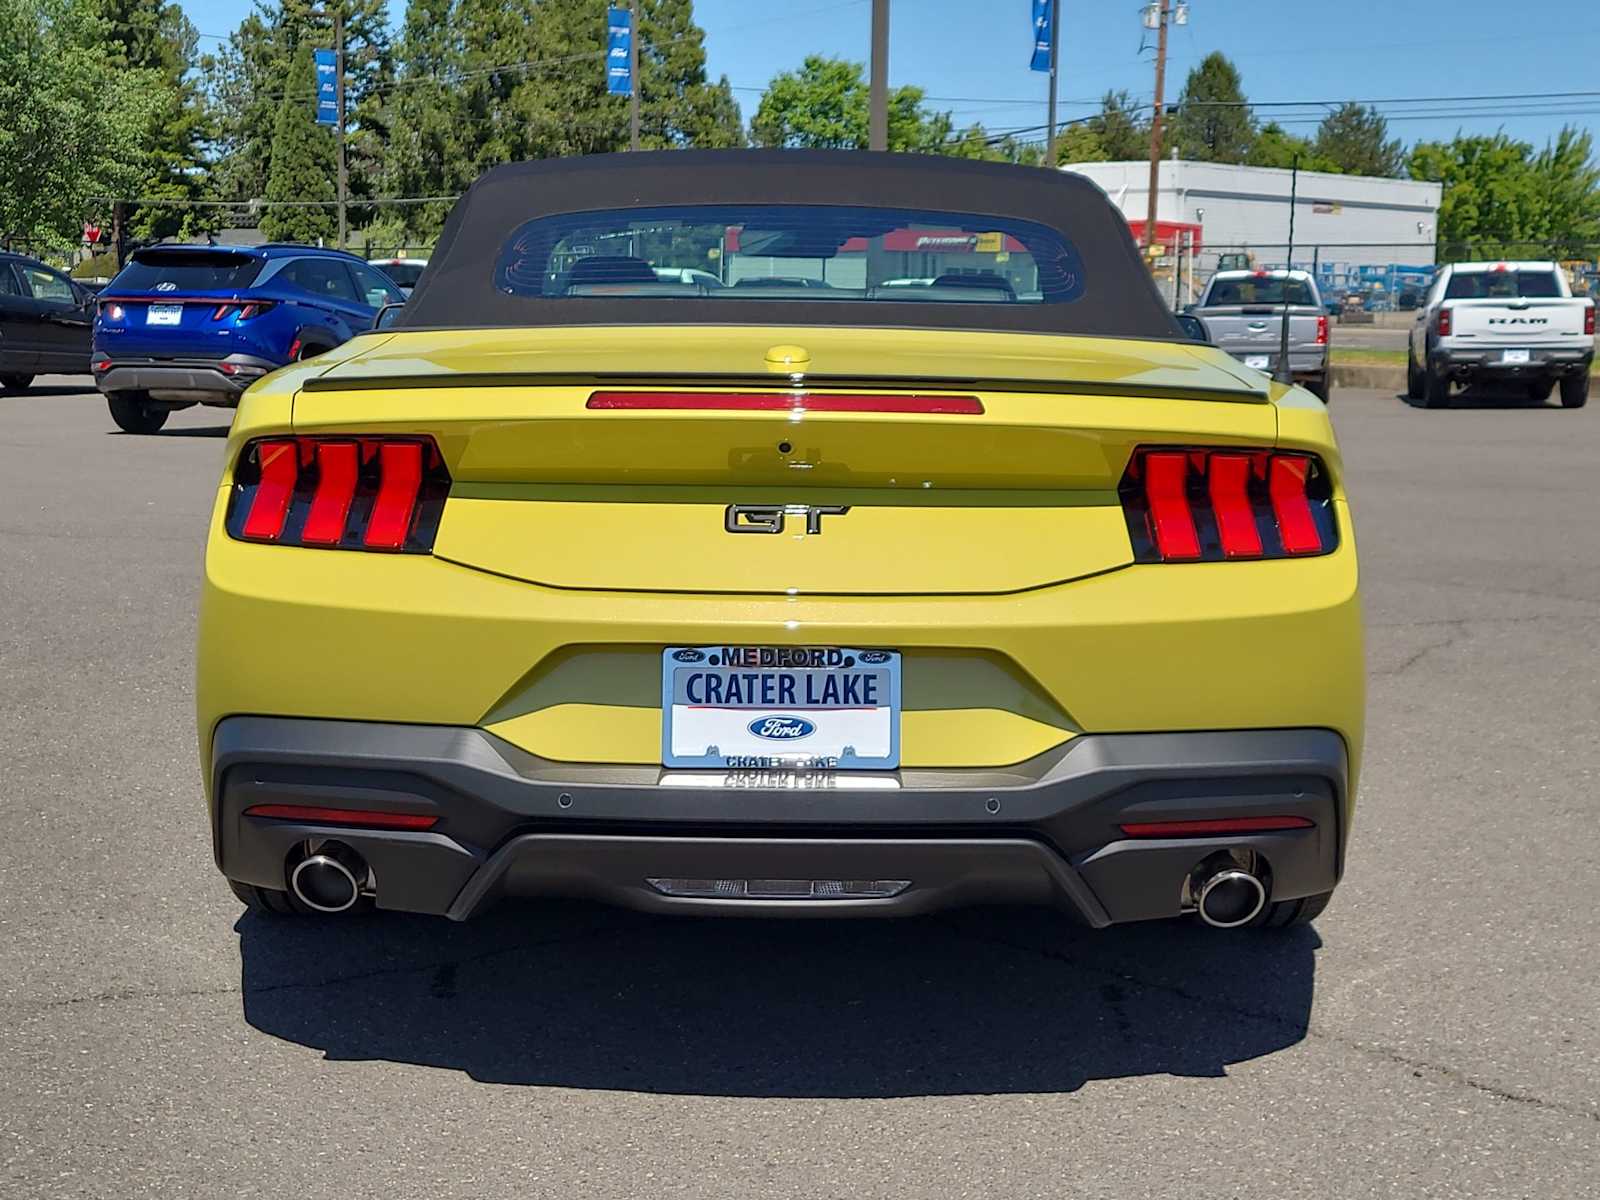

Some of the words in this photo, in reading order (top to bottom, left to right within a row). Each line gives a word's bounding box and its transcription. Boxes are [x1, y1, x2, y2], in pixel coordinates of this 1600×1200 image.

[724, 504, 852, 535] GT
[721, 647, 843, 667] MEDFORD
[686, 673, 796, 704] CRATER
[806, 674, 878, 705] LAKE
[760, 717, 803, 737] Ford
[726, 756, 791, 768] CRATE
